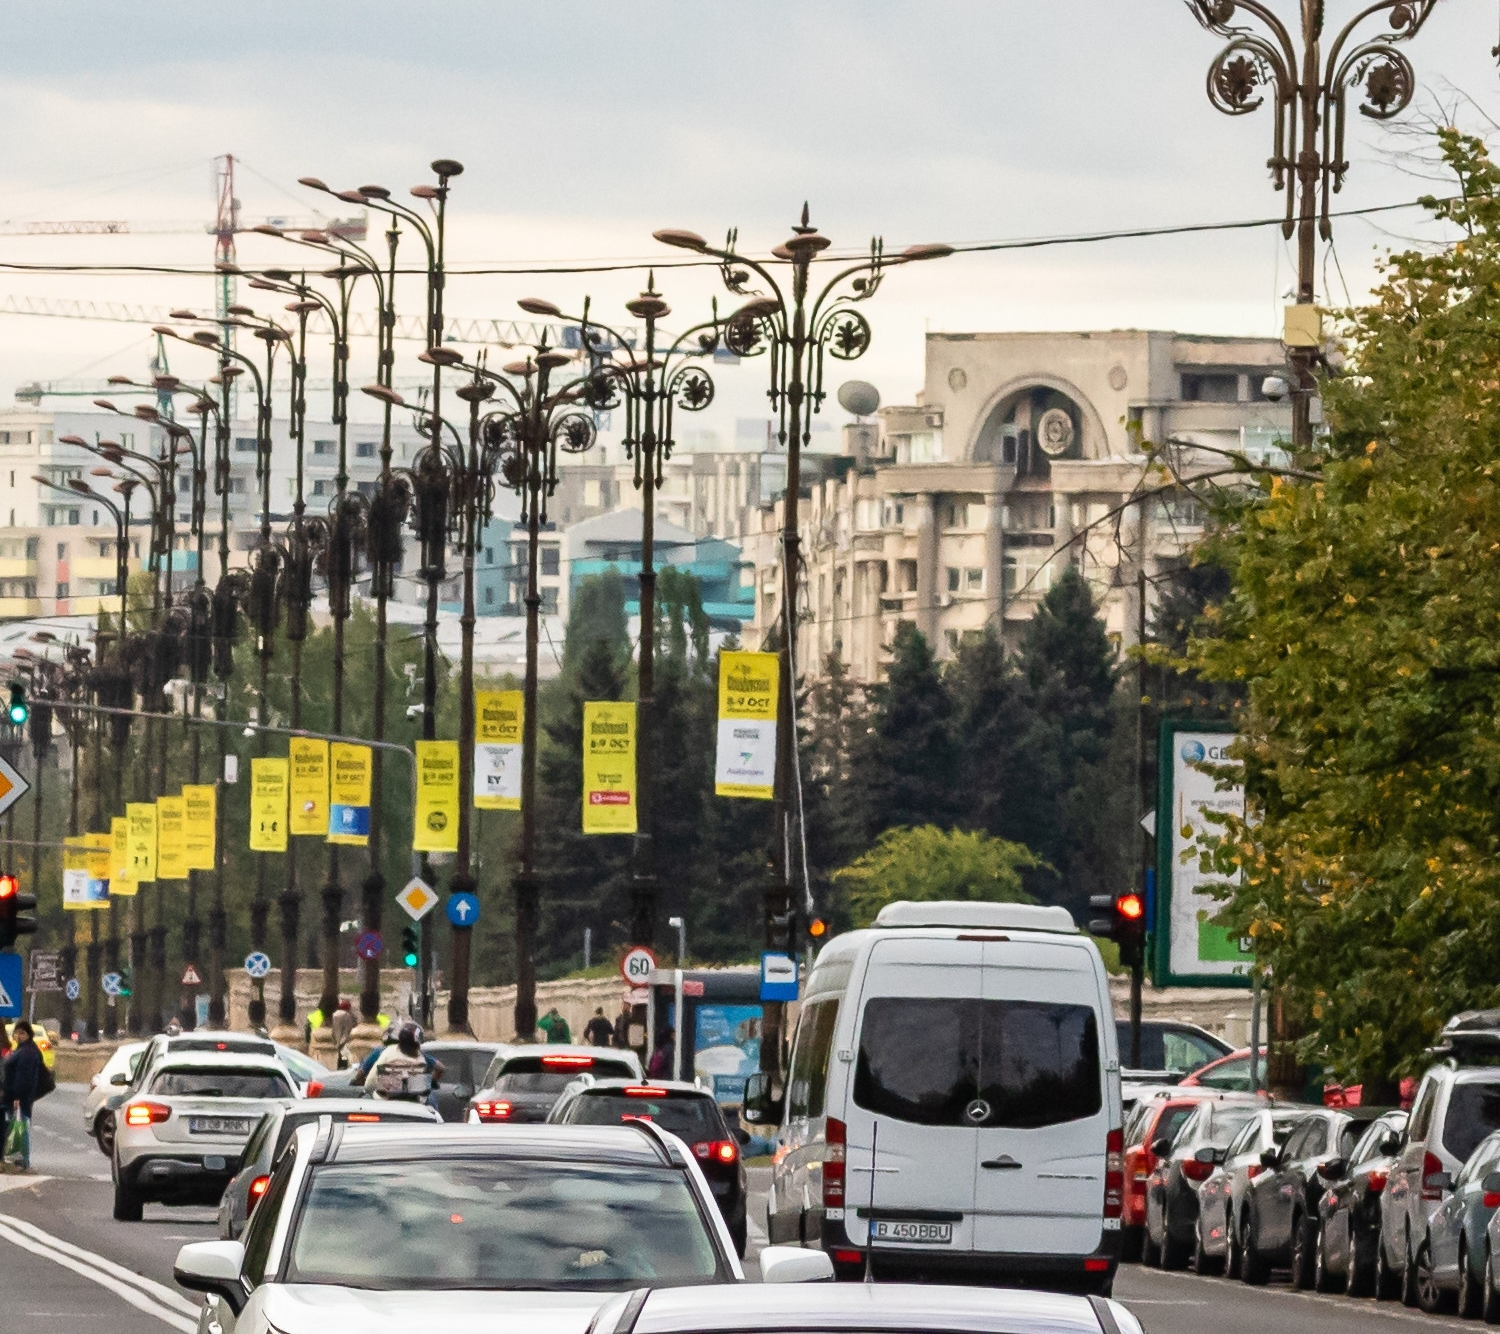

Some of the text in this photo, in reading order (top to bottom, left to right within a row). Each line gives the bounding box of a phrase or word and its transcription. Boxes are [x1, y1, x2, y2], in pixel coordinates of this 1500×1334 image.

[747, 697, 770, 708] OCT
[487, 775, 502, 784] EY
[629, 957, 650, 976] 60
[878, 1222, 949, 1240] B 450 BBU
